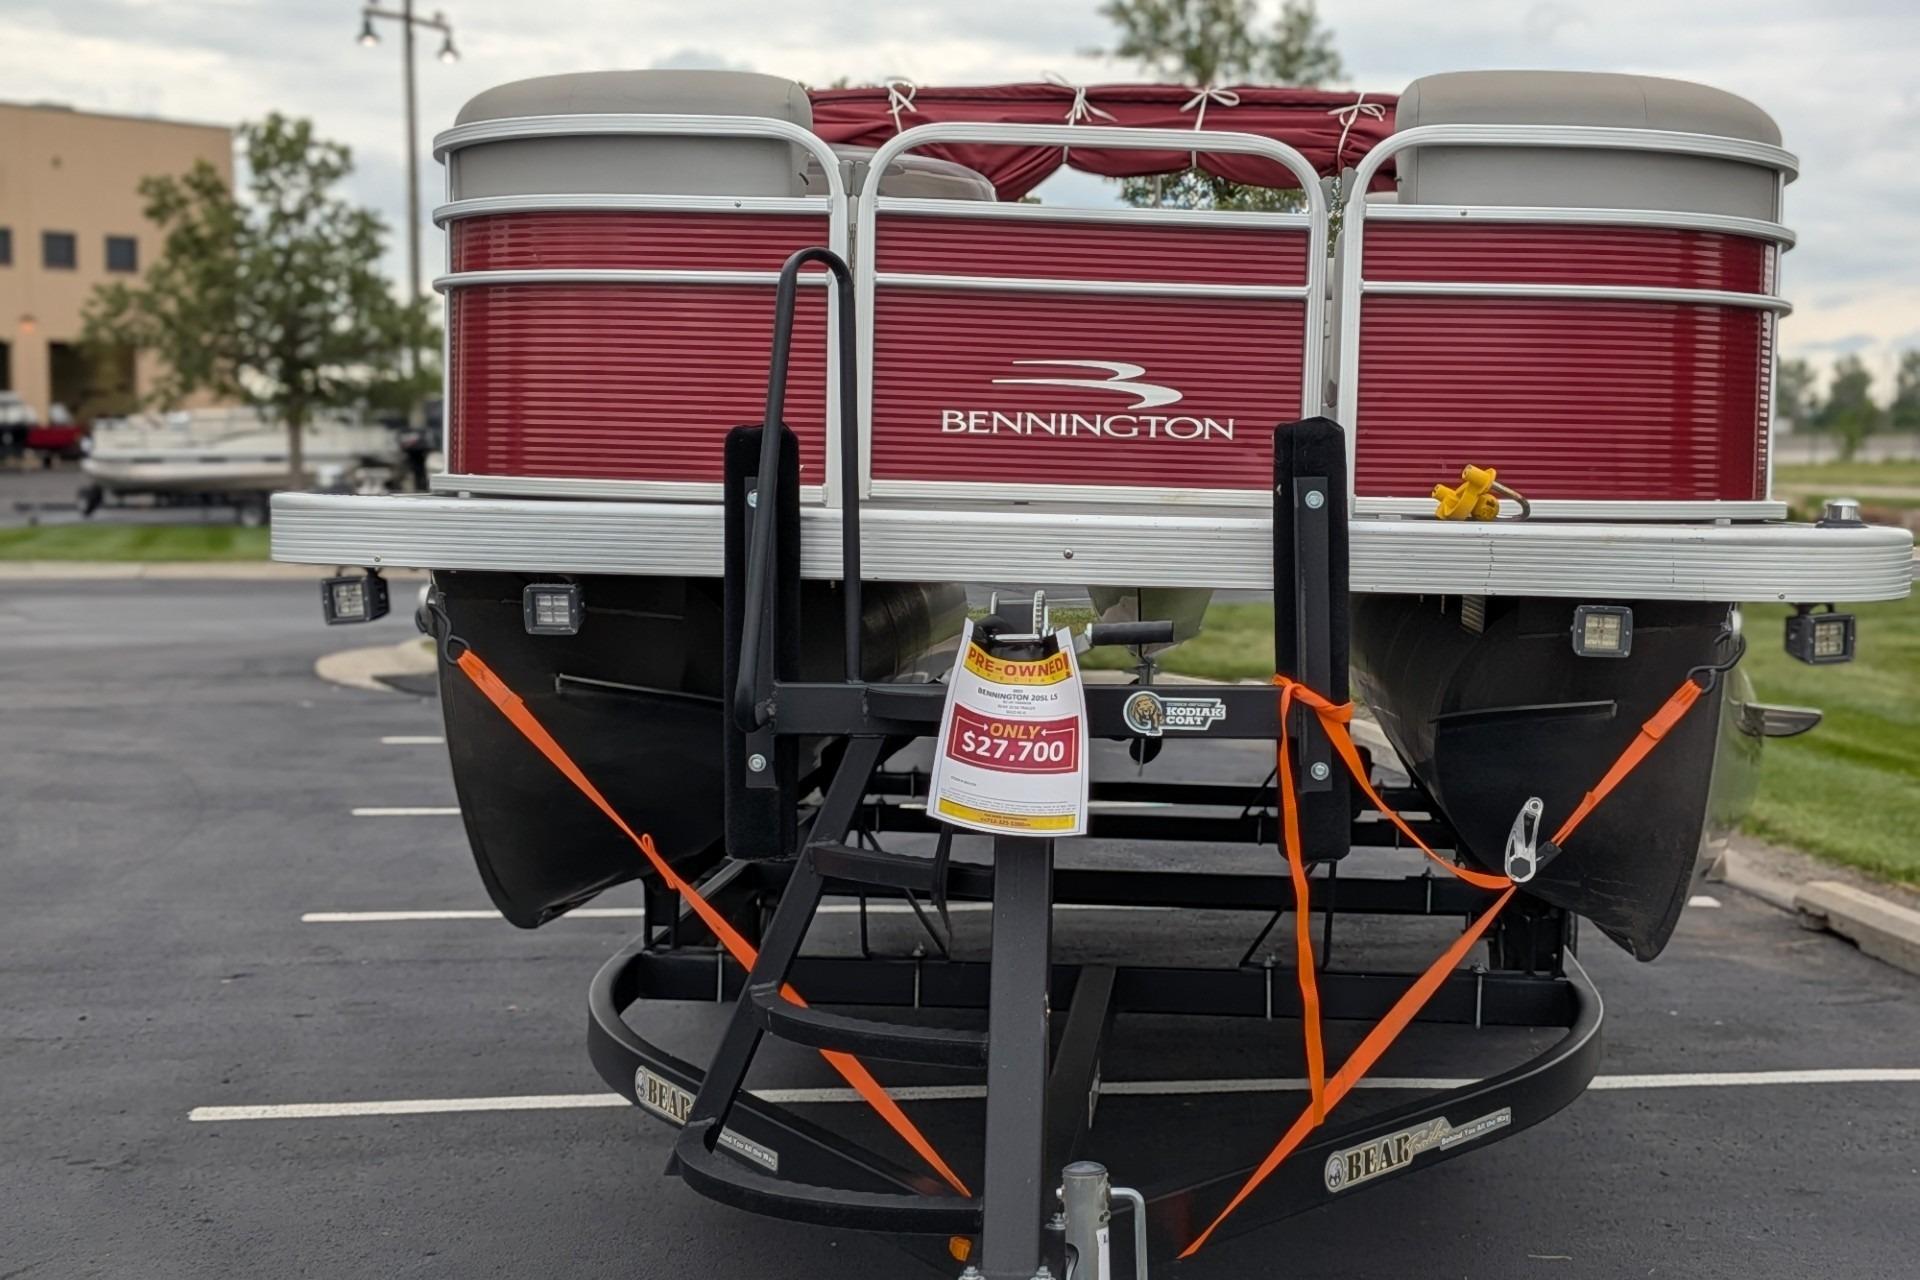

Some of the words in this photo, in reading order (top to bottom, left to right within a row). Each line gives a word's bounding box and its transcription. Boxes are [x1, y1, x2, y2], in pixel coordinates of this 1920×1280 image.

[941, 410, 1235, 440] BENNINGTON
[967, 646, 1073, 678] PRE-OWNED!
[977, 687, 1030, 701] BENNINGTON
[1166, 706, 1222, 717] KODIAK
[1166, 716, 1204, 725] COAT
[990, 722, 1041, 740] ONLY
[1346, 1133, 1411, 1183] BEAR
